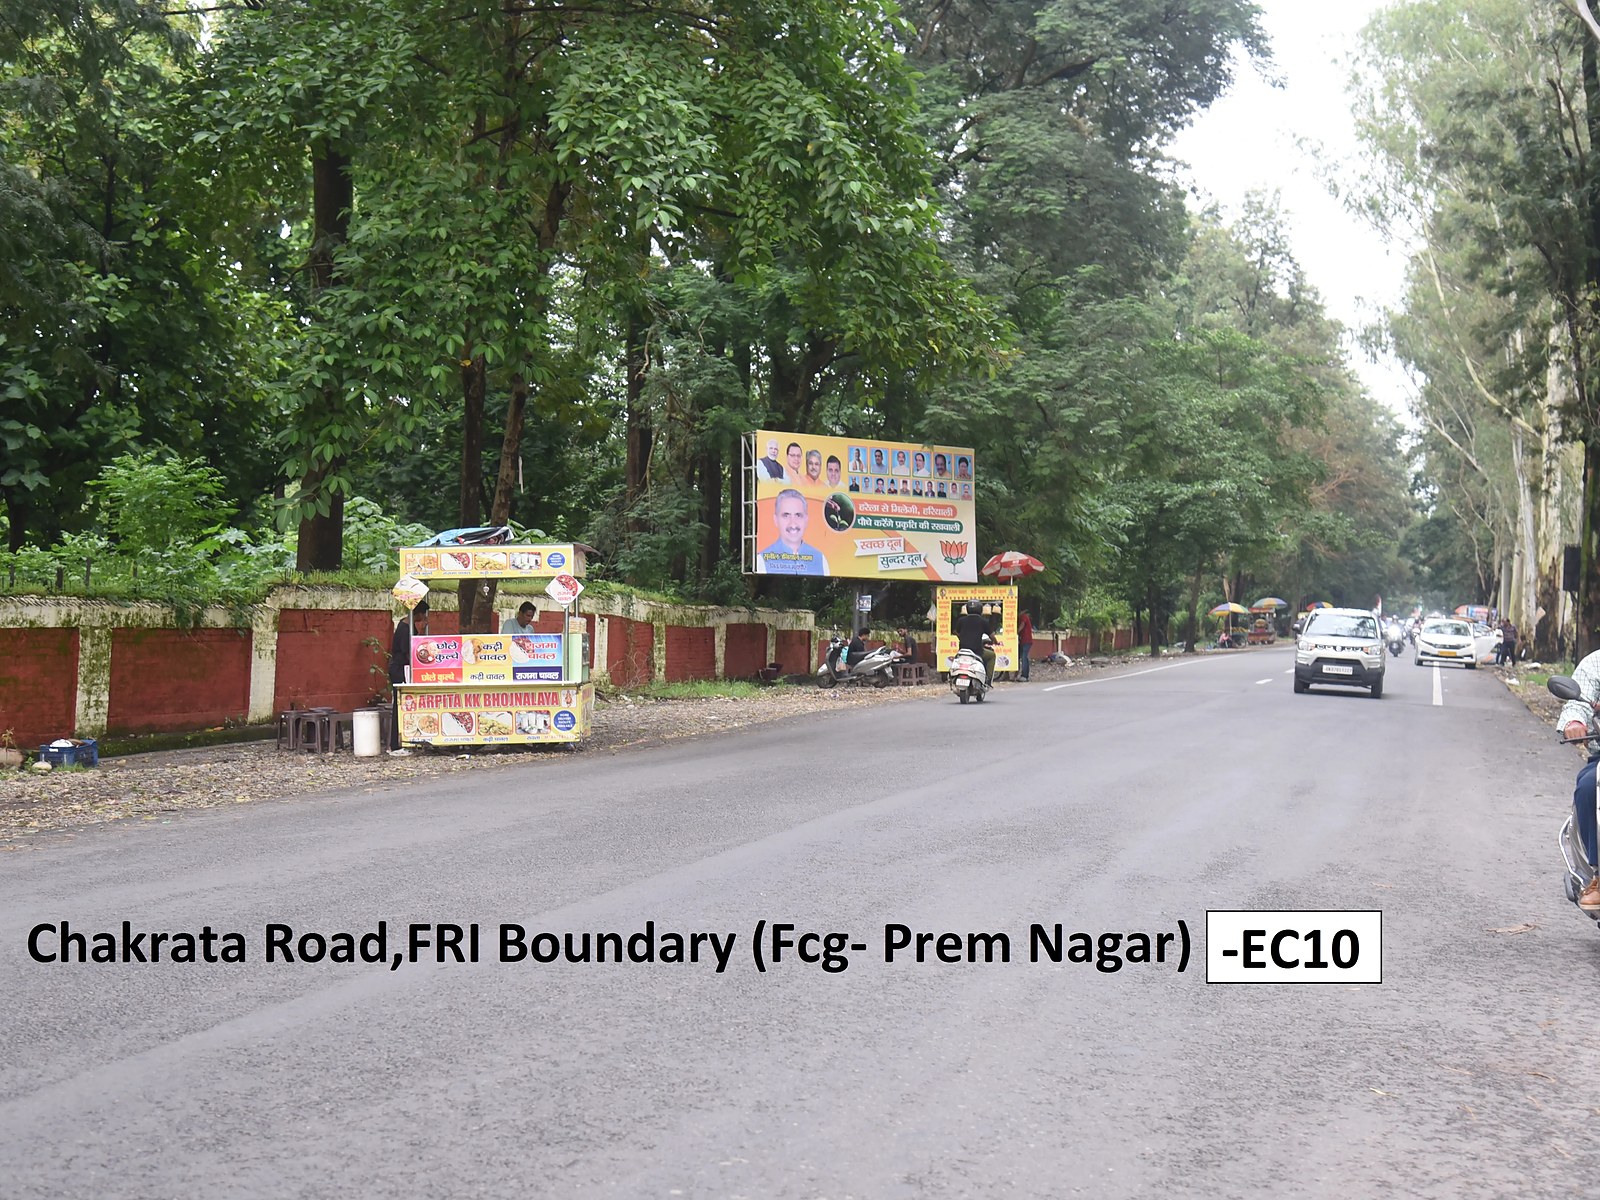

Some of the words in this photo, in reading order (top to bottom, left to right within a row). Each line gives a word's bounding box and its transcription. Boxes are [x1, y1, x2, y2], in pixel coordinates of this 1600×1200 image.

[881, 503, 889, 512] से
[919, 520, 929, 530] की
[860, 539, 885, 550] स्वच्छ
[887, 539, 903, 552] दून
[879, 555, 905, 568] सुन्दर
[907, 554, 922, 566] दून
[436, 641, 458, 650] छोले
[516, 672, 538, 680] राजमा
[418, 694, 462, 709] ARPITA
[464, 693, 481, 708] KK
[483, 691, 560, 708] BHOJNALAYA
